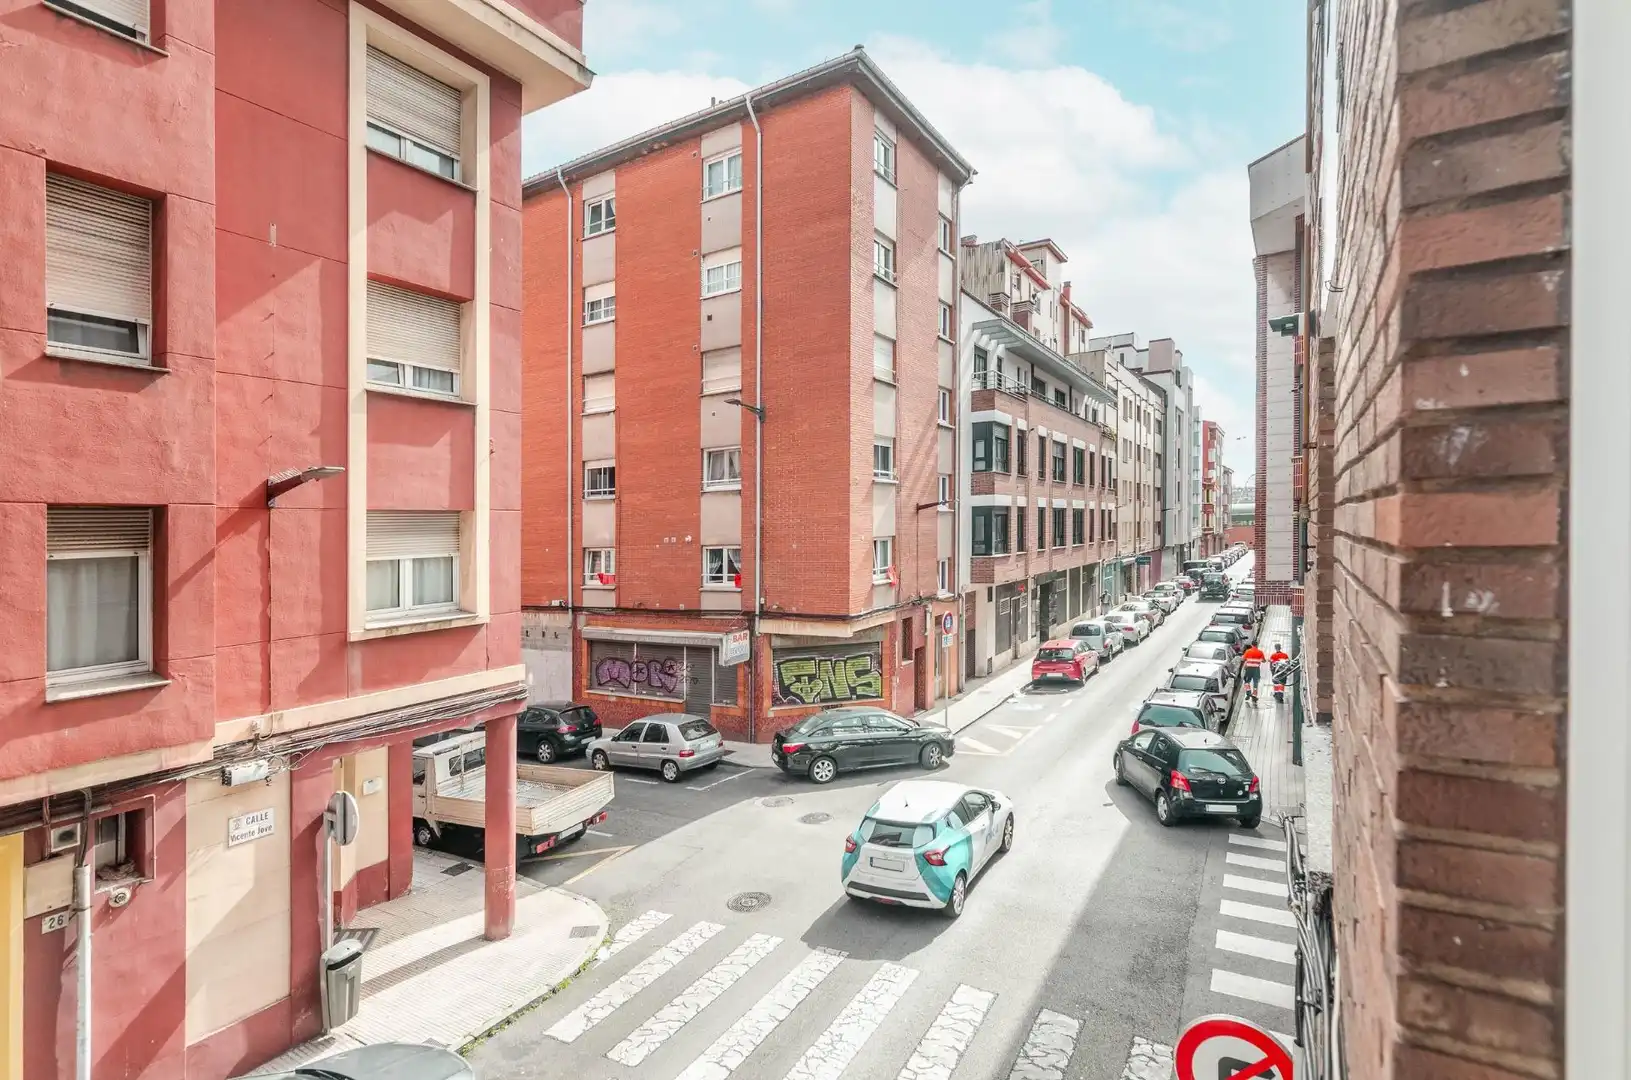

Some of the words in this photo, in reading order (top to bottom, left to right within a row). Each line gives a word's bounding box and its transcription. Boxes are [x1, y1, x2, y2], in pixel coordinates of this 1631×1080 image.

[732, 632, 748, 643] BAR
[245, 811, 269, 825] CALLE
[230, 830, 256, 842] Vicente
[48, 914, 64, 930] 26
